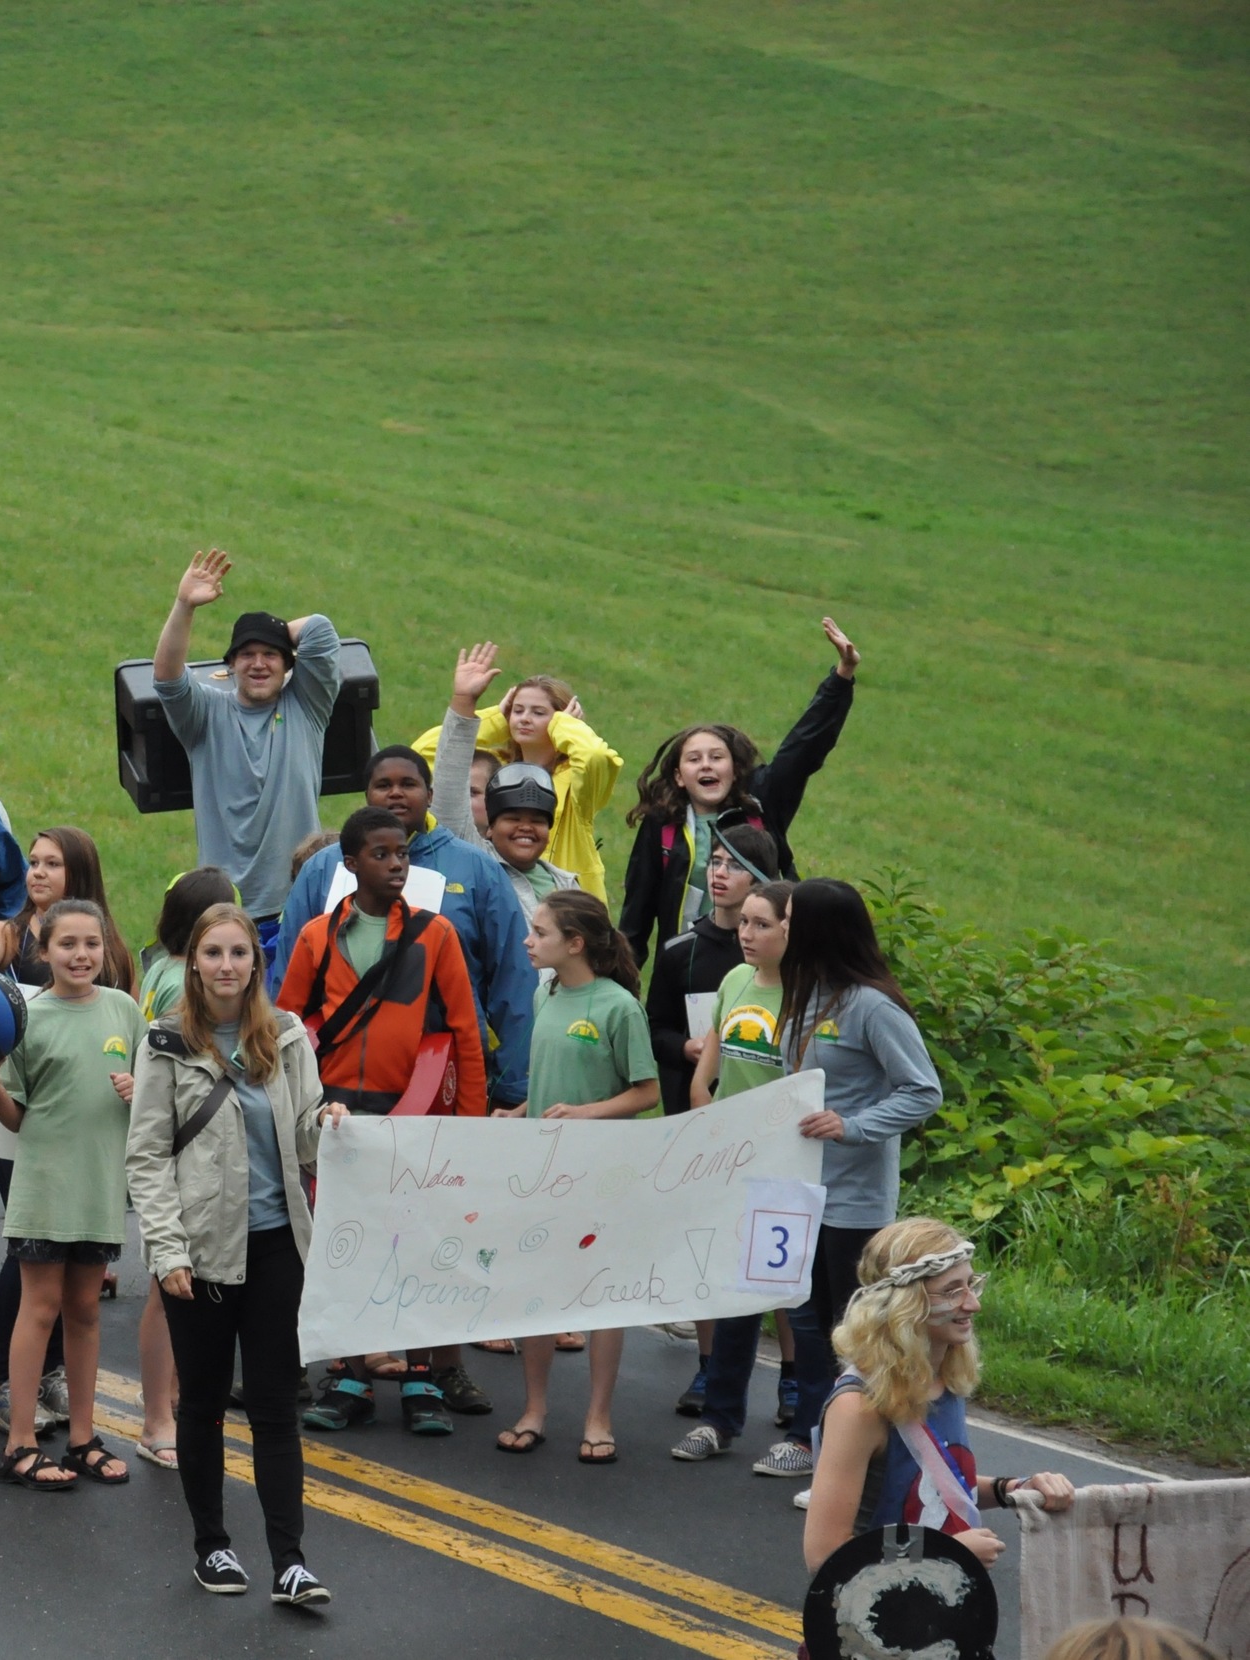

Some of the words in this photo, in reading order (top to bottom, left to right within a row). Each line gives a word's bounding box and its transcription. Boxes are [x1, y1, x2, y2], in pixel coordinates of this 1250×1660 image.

[379, 1117, 467, 1194] Welcome
[507, 1123, 588, 1198] To
[641, 1112, 757, 1193] Camp
[353, 1246, 501, 1333] Spring
[767, 1226, 790, 1269] 3
